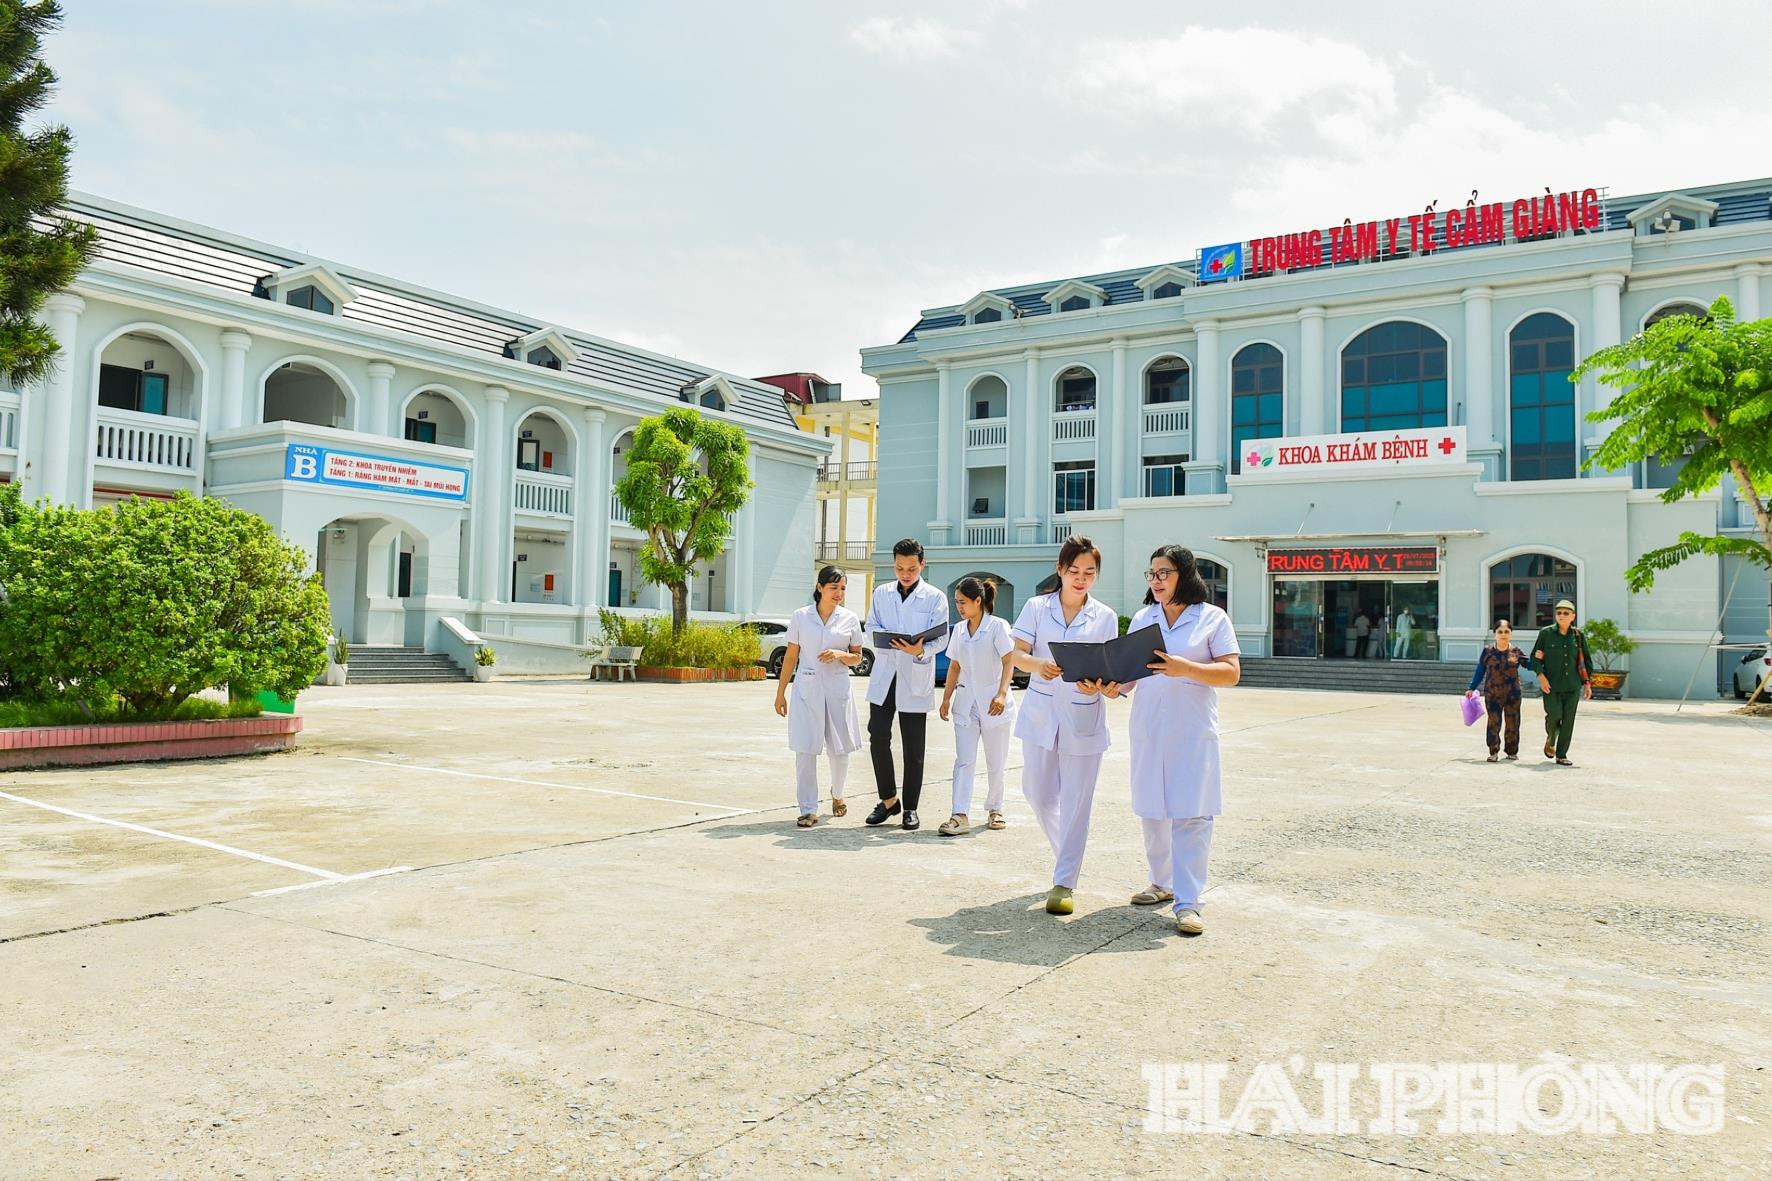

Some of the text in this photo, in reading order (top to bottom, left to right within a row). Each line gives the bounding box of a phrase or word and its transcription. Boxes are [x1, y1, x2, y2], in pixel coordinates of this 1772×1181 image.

[1250, 187, 1599, 276] TRUNG TÂM Y TẾ CẨM GIÀNG
[1278, 434, 1429, 465] KHOA KHÁM BỆNH
[291, 454, 317, 479] B
[356, 460, 372, 470] KHOA
[1329, 551, 1369, 570] TÂM
